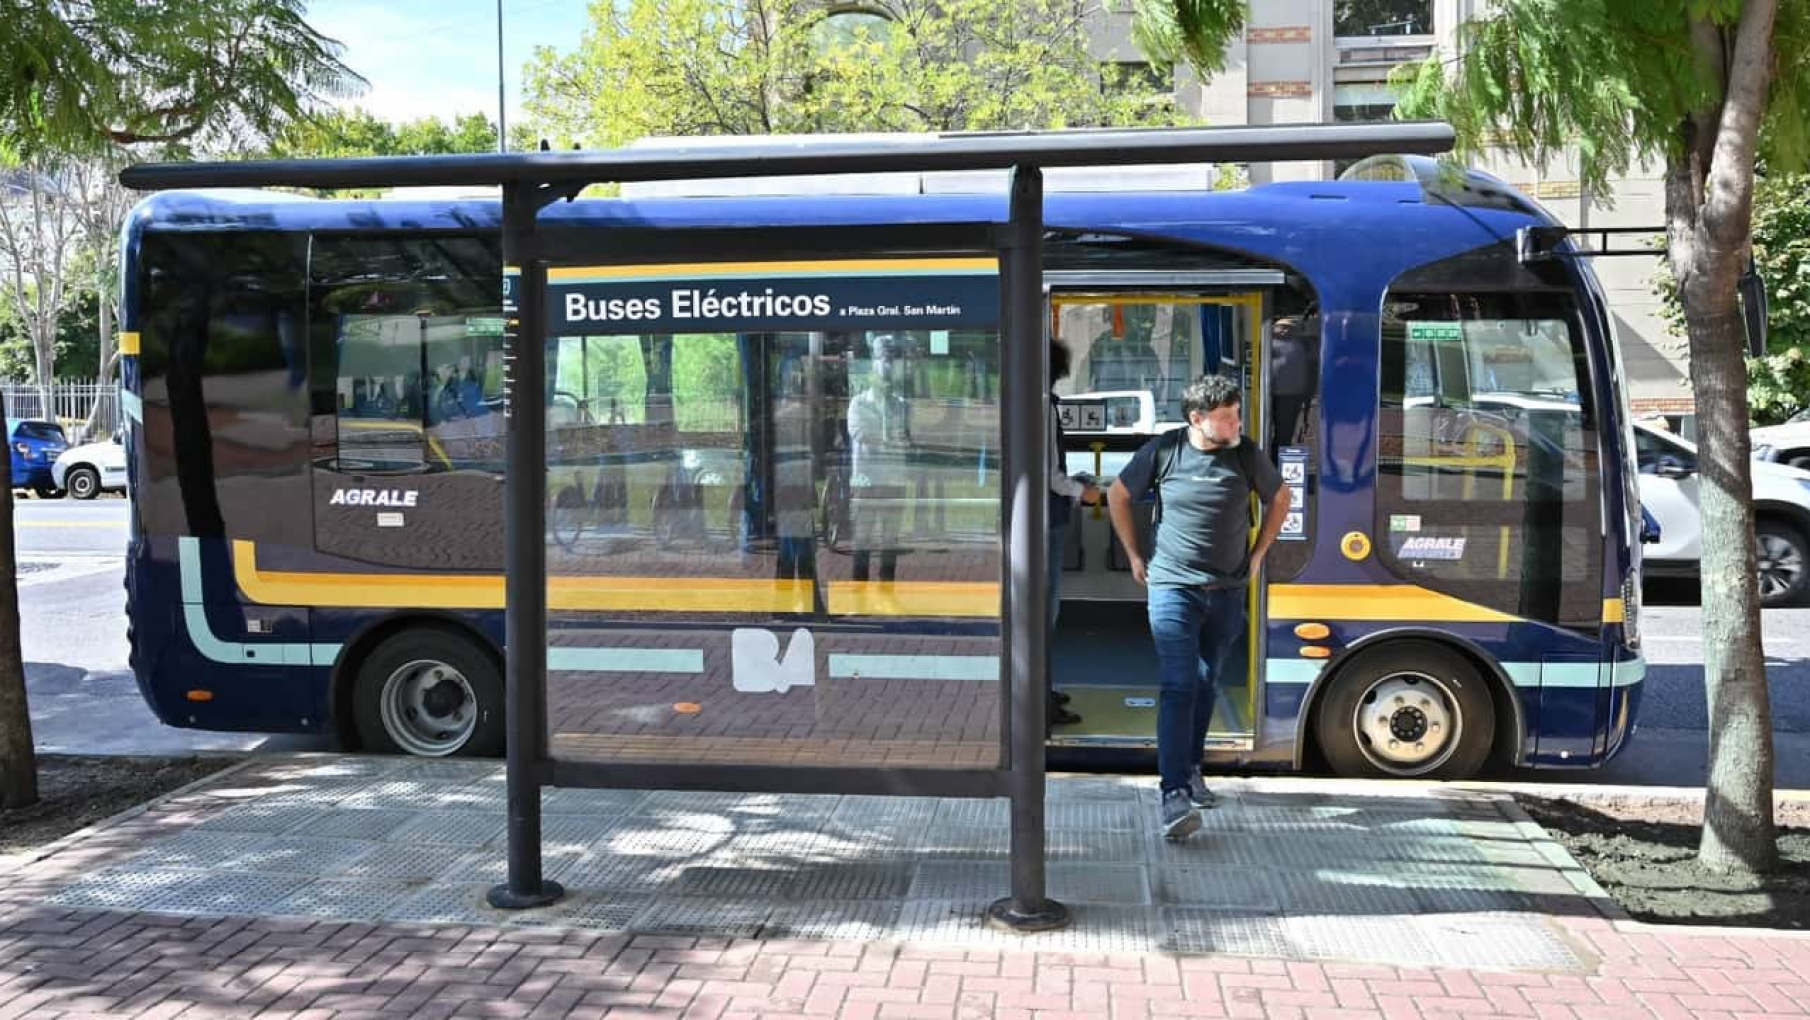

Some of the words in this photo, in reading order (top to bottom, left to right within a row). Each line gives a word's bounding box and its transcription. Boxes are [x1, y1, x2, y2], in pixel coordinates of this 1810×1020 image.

[565, 293, 661, 321] Buses
[671, 288, 830, 318] Eléctricos
[848, 306, 875, 316] Plaza
[903, 305, 924, 316] San
[329, 489, 418, 506] AGRALE
[1402, 537, 1466, 550] AGRALE
